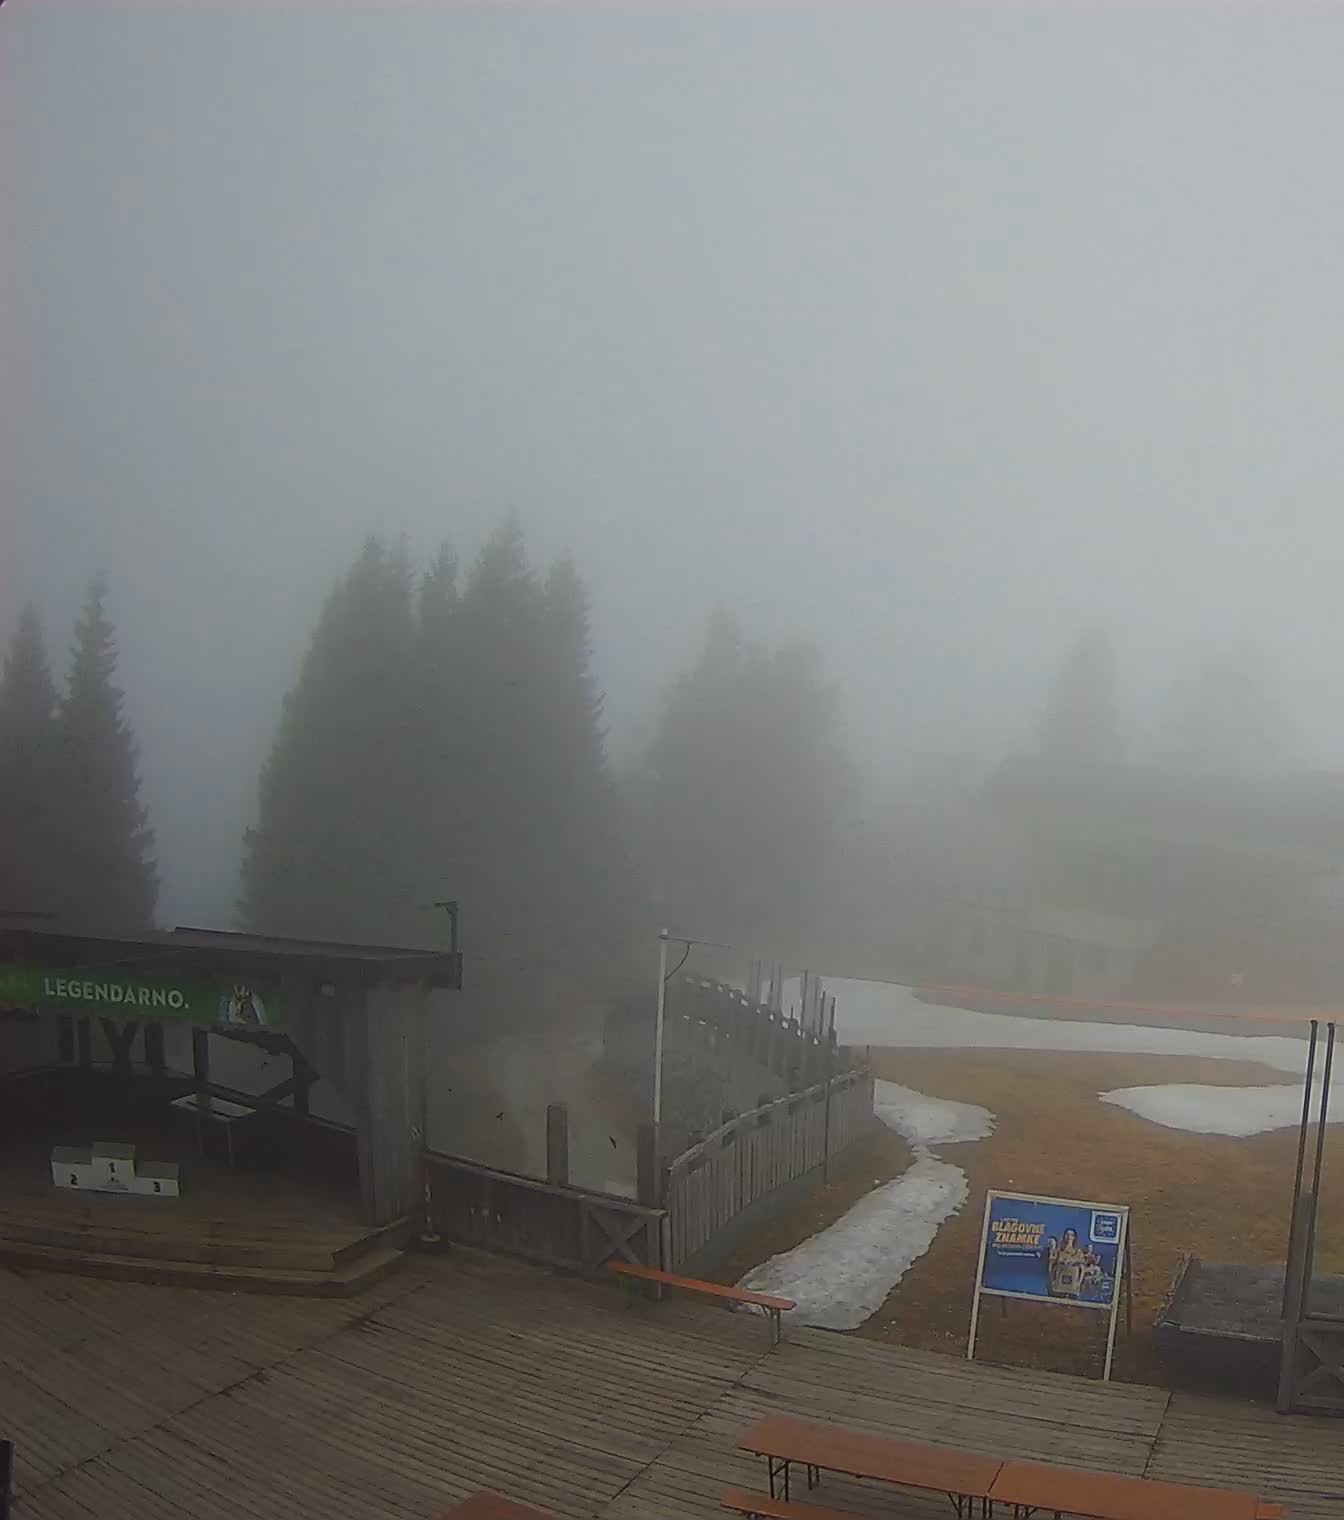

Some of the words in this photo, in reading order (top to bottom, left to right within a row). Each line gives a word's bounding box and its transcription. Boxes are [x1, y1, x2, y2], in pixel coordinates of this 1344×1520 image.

[44, 977, 189, 1009] LEGENDARNO.
[108, 1162, 116, 1173] 1
[70, 1173, 78, 1186] 2
[153, 1181, 161, 1193] 3
[995, 1232, 1040, 1245] ZNAMKE
